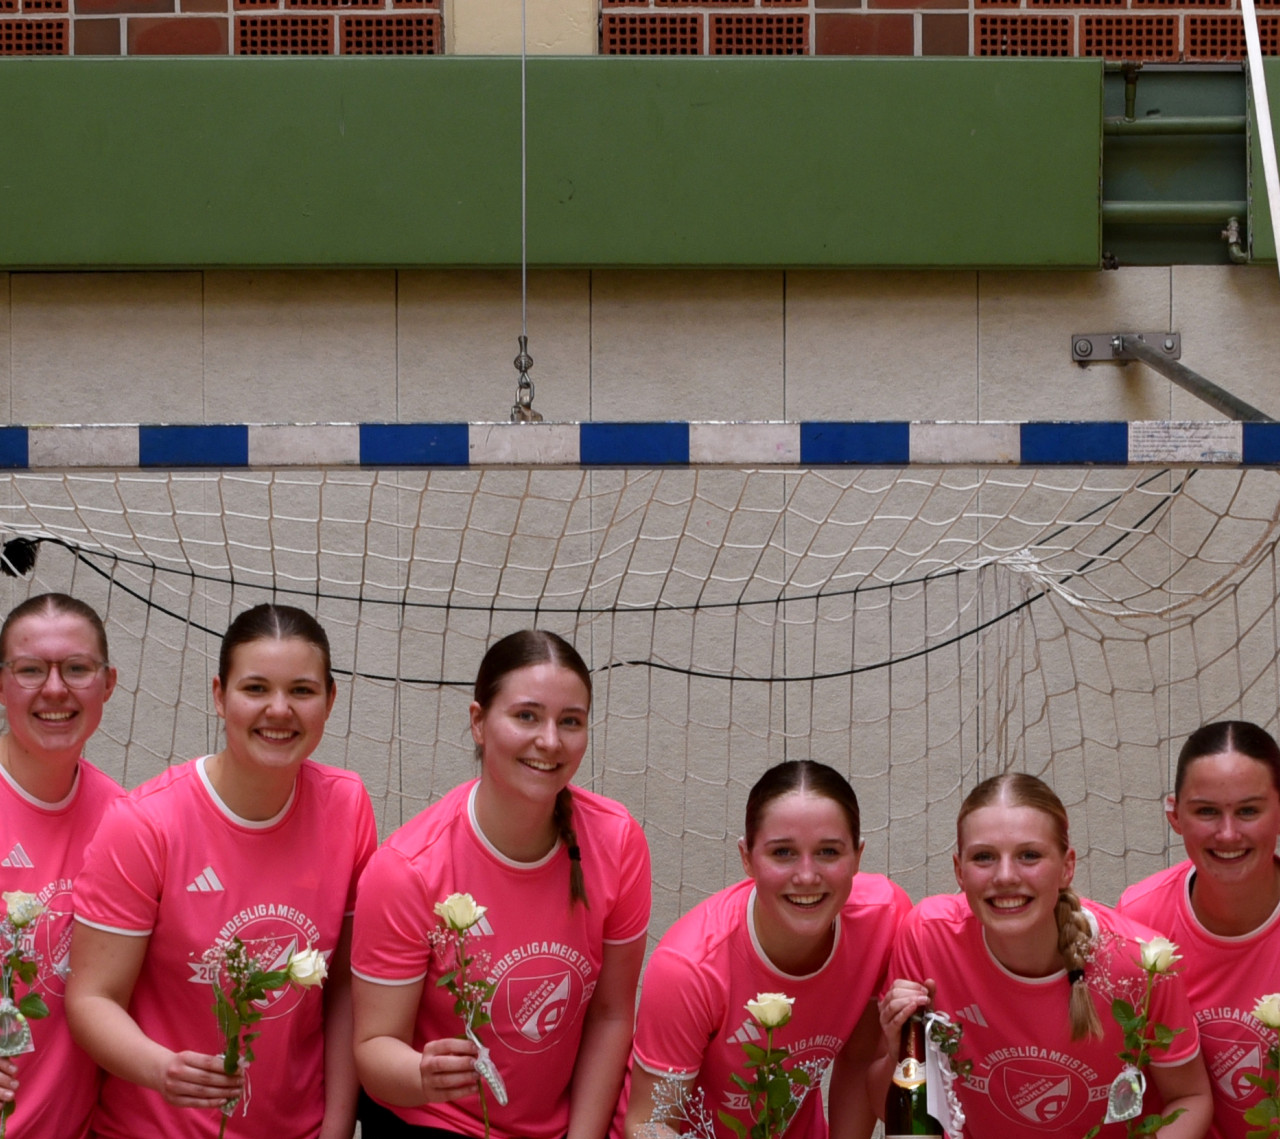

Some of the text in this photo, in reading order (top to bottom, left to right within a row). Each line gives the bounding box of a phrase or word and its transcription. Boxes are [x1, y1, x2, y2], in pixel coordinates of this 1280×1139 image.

[214, 903, 320, 947] ANDESLIGAMEISTER
[486, 941, 592, 985] ANDESLIGAMEISTER
[733, 1096, 749, 1108] 20
[1091, 1088, 1107, 1099] 26
